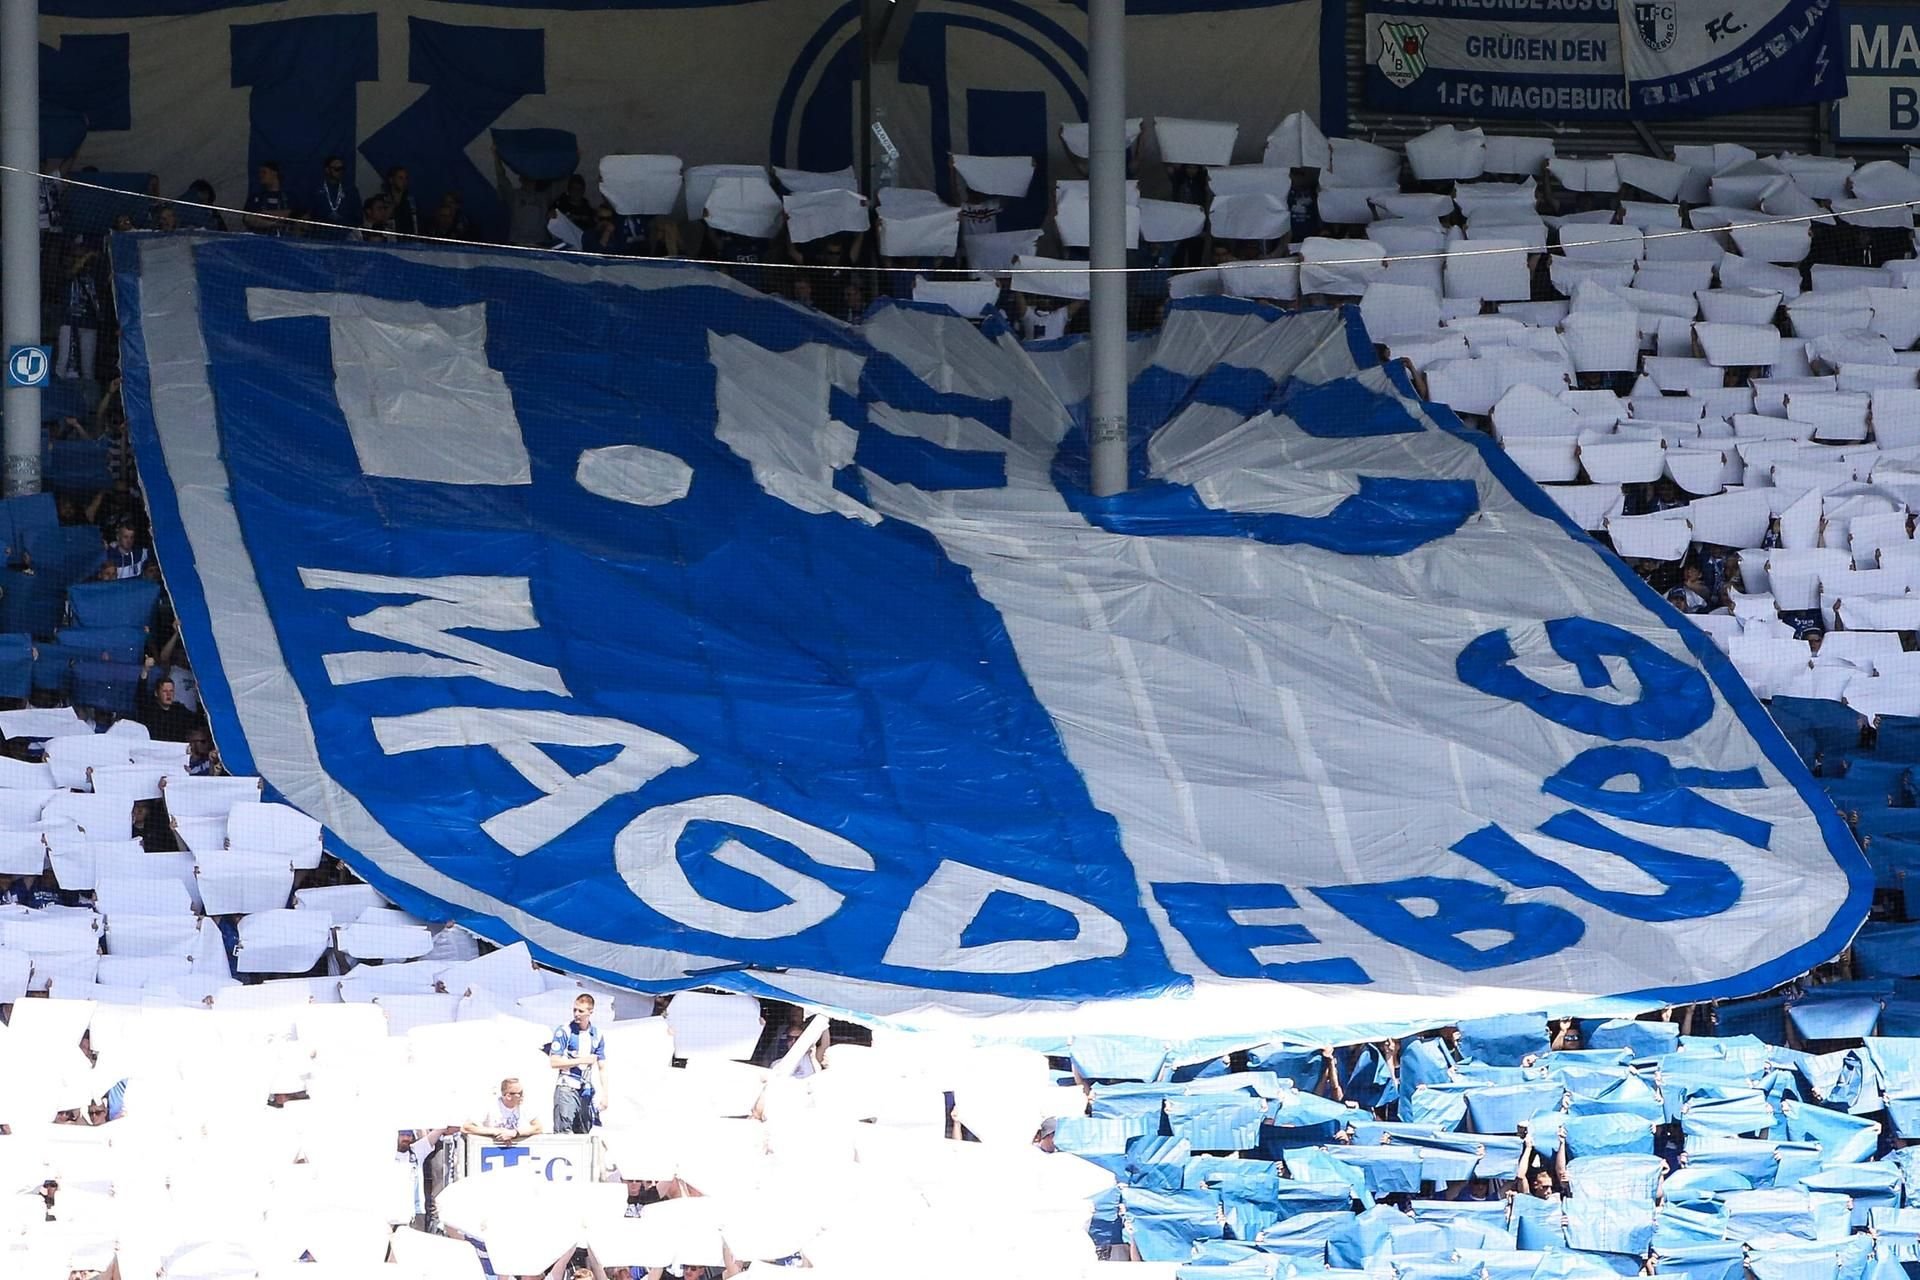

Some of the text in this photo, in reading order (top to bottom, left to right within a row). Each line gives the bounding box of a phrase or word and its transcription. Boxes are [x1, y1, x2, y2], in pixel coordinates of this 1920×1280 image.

[1563, 40, 1607, 61] DEN
[1437, 82, 1485, 106] 1.FC
[1890, 87, 1920, 130] B
[301, 567, 1776, 984] MAGDEBURG
